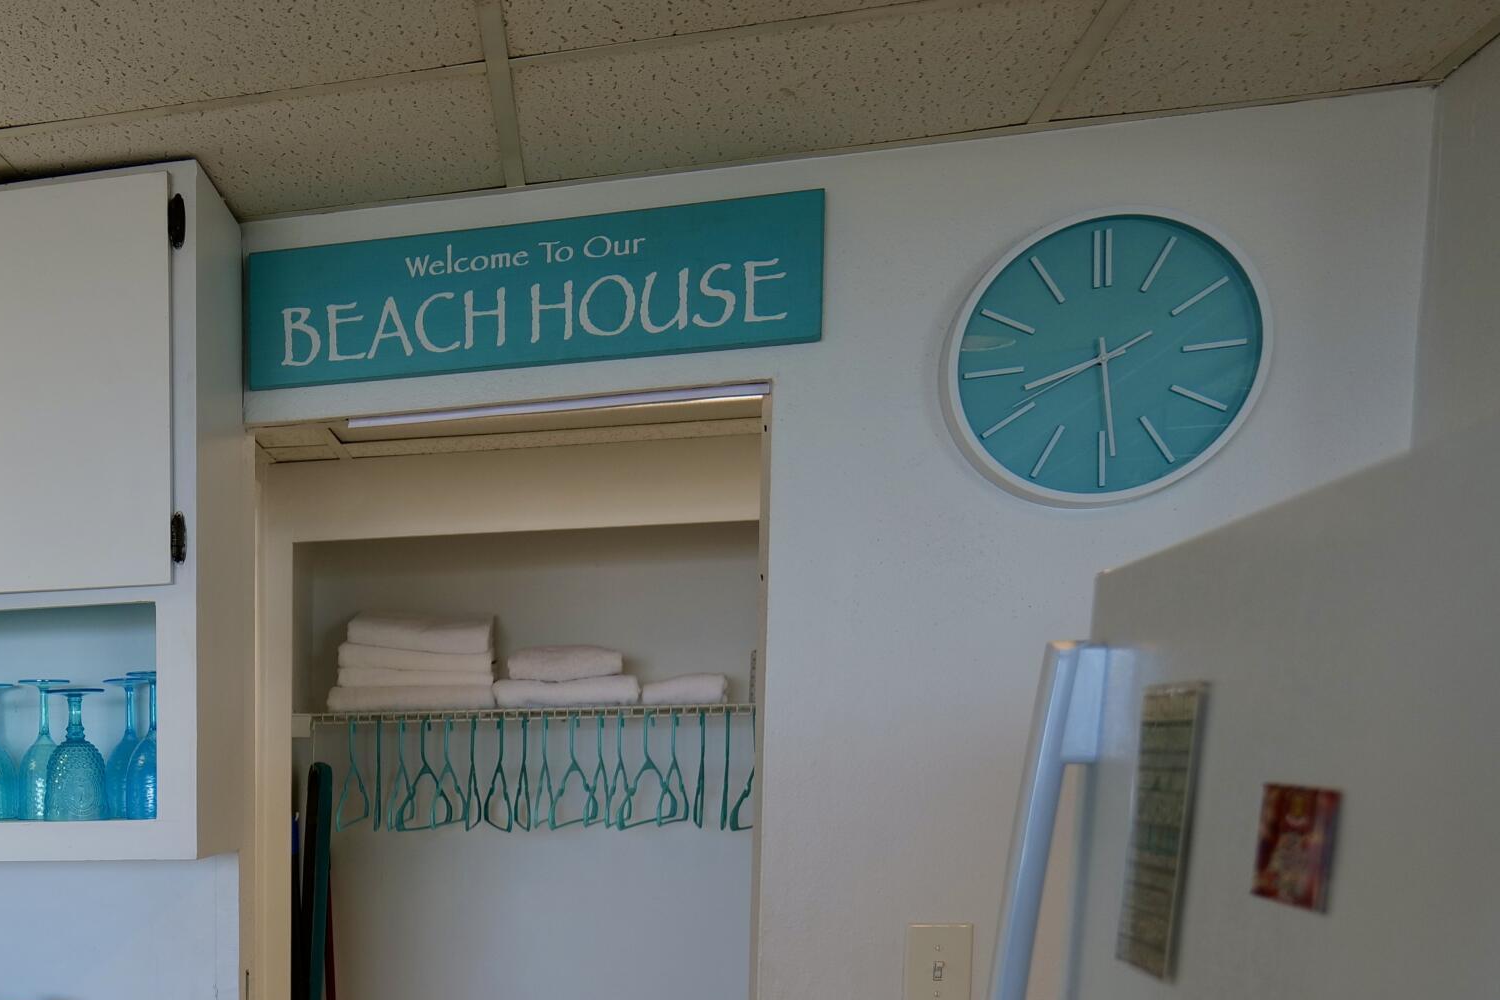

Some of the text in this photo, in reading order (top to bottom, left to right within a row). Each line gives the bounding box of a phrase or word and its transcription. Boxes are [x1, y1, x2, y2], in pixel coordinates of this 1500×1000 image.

[405, 235, 646, 279] Welcome To Our
[280, 257, 788, 367] BEACH HOUSE
